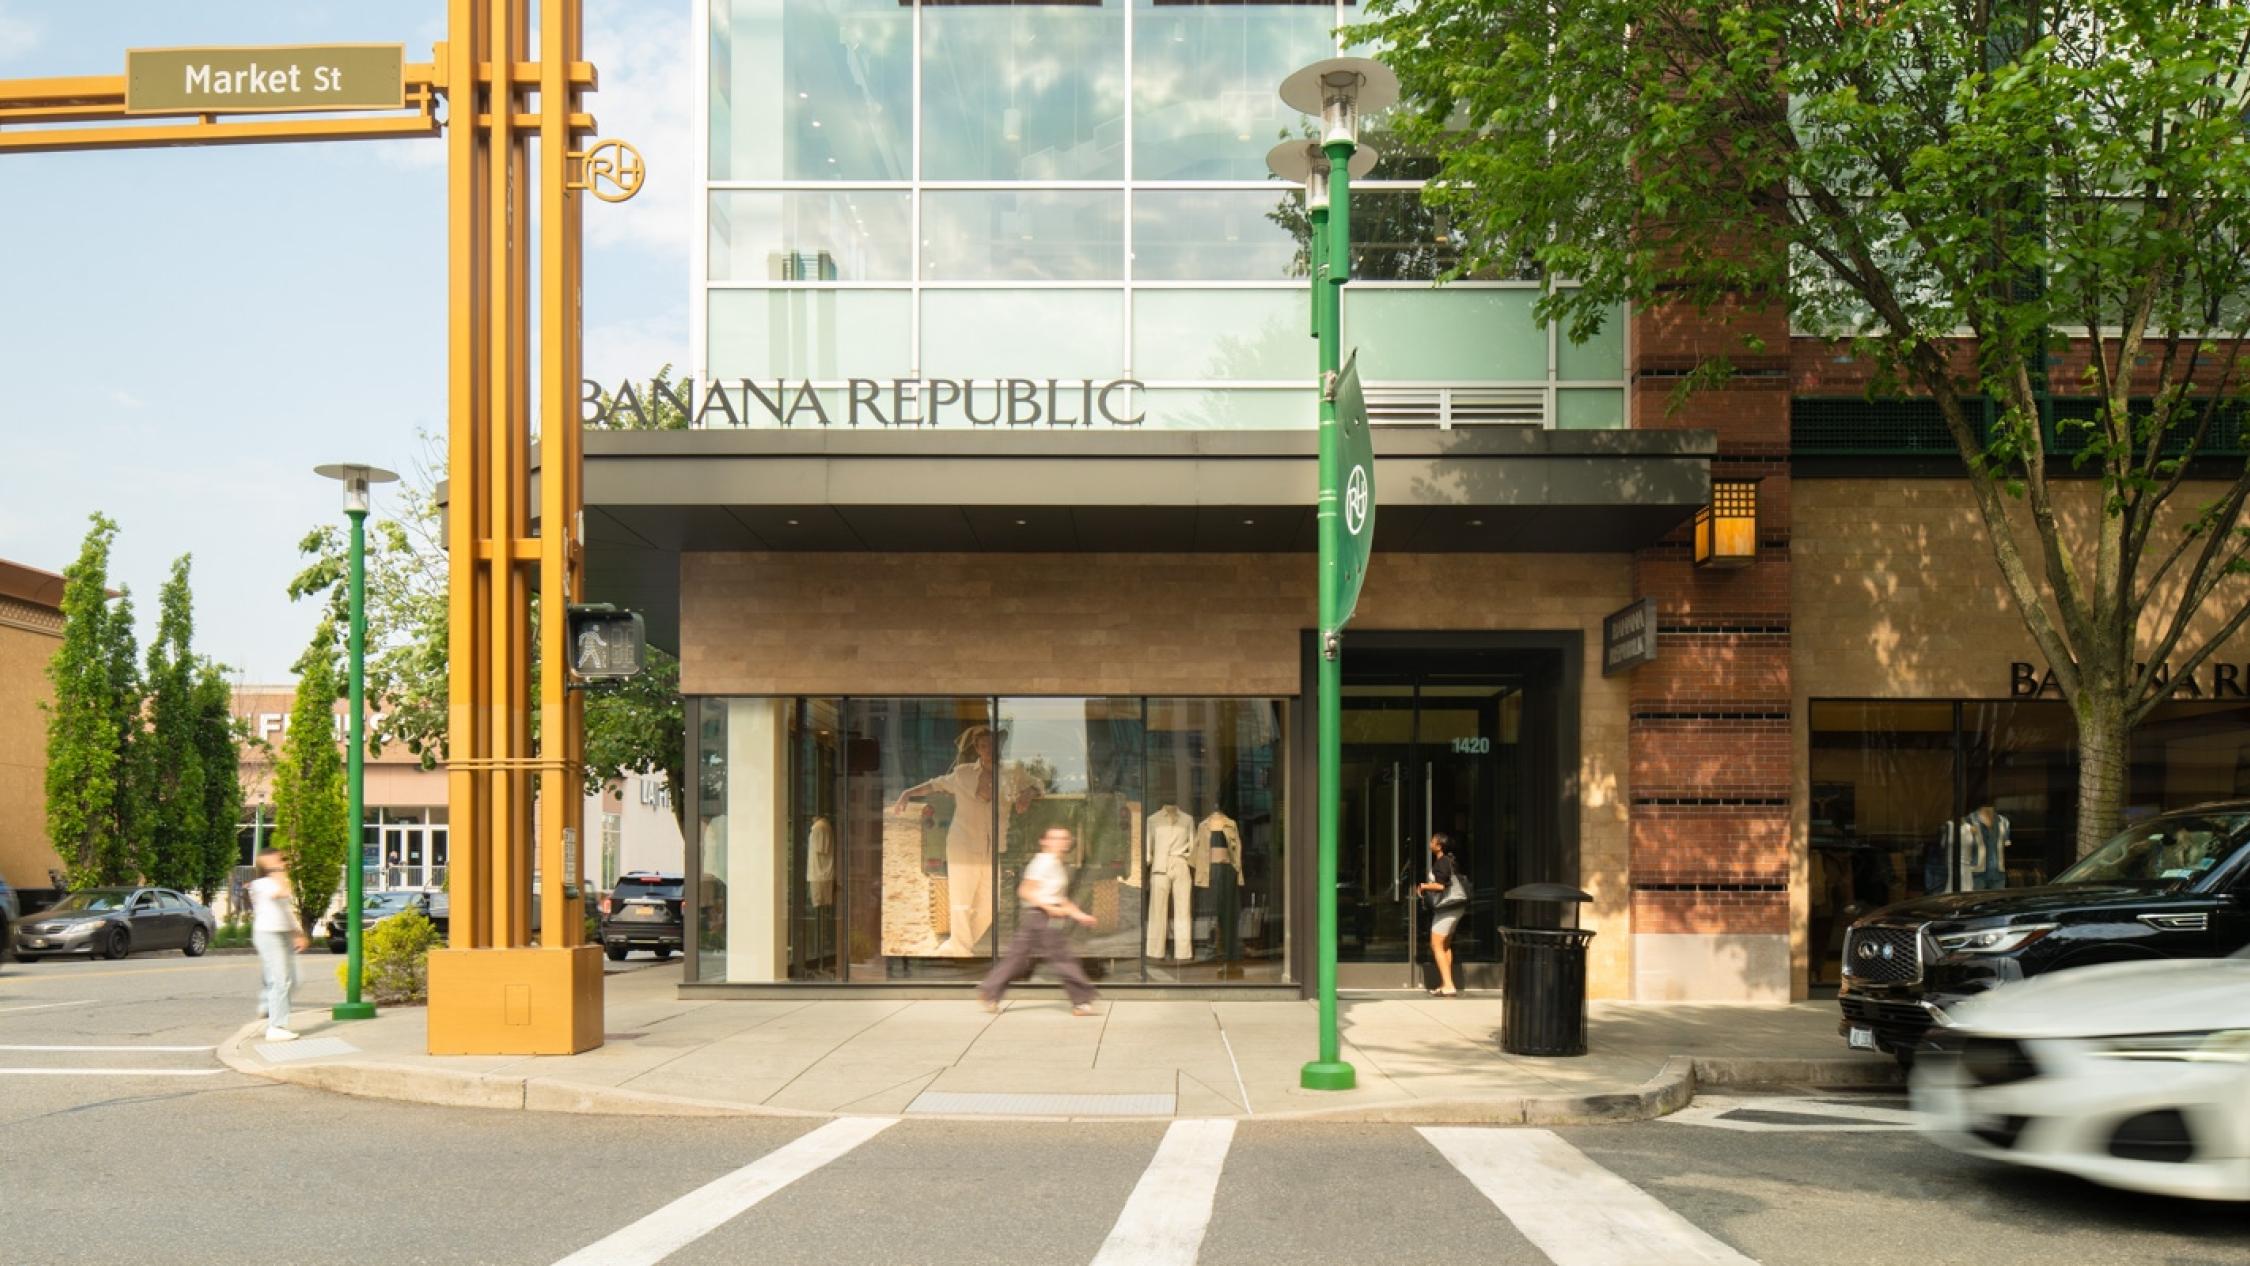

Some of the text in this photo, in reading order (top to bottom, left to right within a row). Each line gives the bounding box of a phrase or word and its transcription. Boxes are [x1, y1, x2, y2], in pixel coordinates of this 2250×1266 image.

[185, 63, 342, 94] Market St
[583, 378, 1146, 424] BANANA REPUBLIC
[2214, 663, 2250, 698] R
[1452, 737, 1490, 754] 1420
